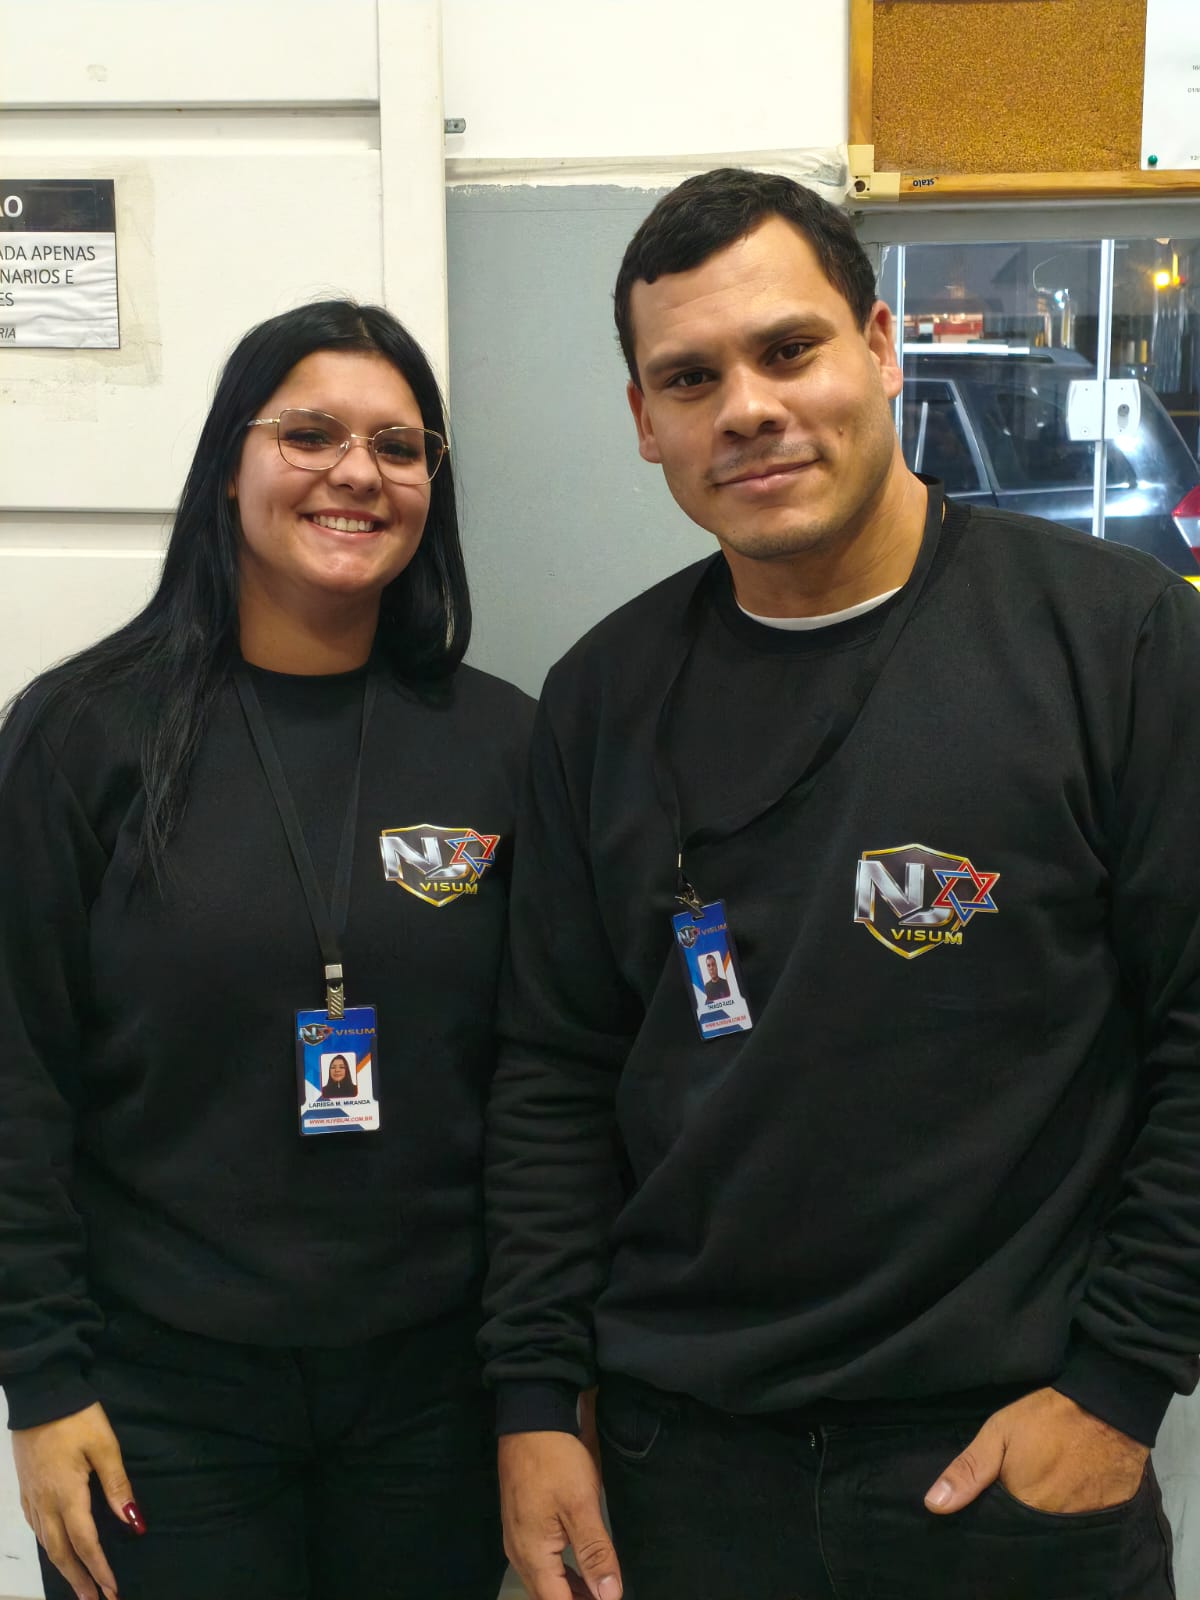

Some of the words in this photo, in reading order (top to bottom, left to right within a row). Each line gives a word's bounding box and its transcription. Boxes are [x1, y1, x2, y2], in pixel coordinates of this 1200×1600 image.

[0, 195, 23, 217] O
[31, 245, 96, 261] APENAS
[0, 268, 60, 285] NARIOS
[65, 269, 74, 284] E
[420, 882, 478, 894] VISUM
[890, 928, 963, 945] VISUM
[336, 1027, 376, 1037] VISUM
